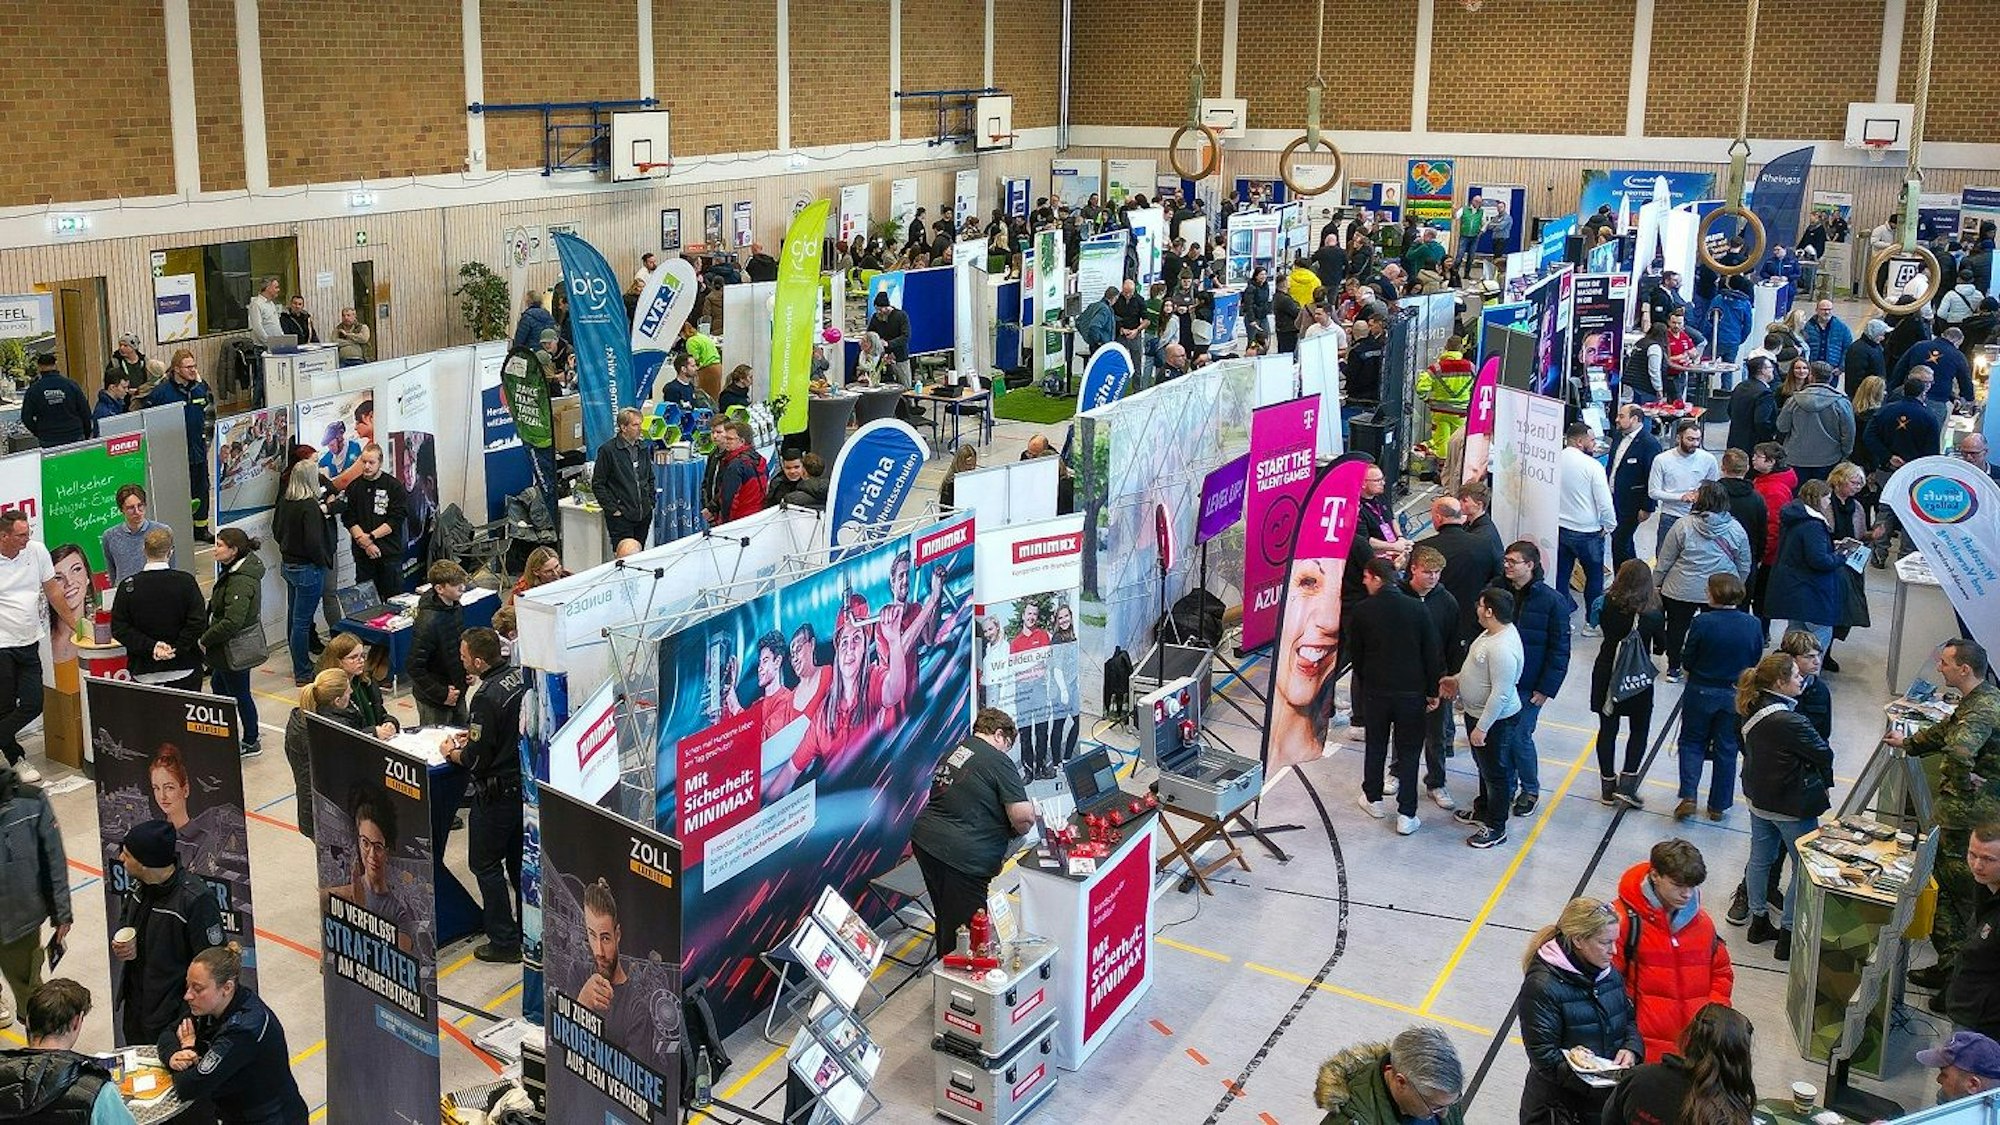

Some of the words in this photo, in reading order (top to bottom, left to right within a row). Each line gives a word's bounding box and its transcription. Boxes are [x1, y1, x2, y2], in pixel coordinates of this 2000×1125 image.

[1761, 173, 1801, 185] Rheingas
[642, 297, 669, 336] LVR
[1256, 453, 1291, 480] START
[1291, 448, 1312, 469] THE
[1256, 474, 1284, 493] TALENT
[851, 455, 896, 522] Präha
[1320, 496, 1347, 542] T
[1254, 583, 1284, 612] AZU
[991, 661, 1005, 672] Wir
[1007, 654, 1034, 668] bilden
[184, 703, 229, 727] ZOLL
[384, 756, 421, 788] ZOLL
[684, 770, 709, 796] Mit
[684, 769, 755, 815] Sicherheit:
[684, 785, 755, 836] MINIMAX
[630, 836, 673, 875] ZOLL
[329, 896, 344, 919] DU
[345, 903, 397, 946] VERFOLGST
[325, 916, 418, 993] STRAFTÄTER
[337, 954, 354, 979] AM
[557, 995, 571, 1018] DU
[572, 1001, 603, 1037] ZIEHST
[553, 1011, 663, 1107] DROGENKURIERE
[565, 1049, 585, 1077] AUS
[586, 1062, 606, 1092] DEM
[608, 1076, 652, 1123] VERKEHR.
